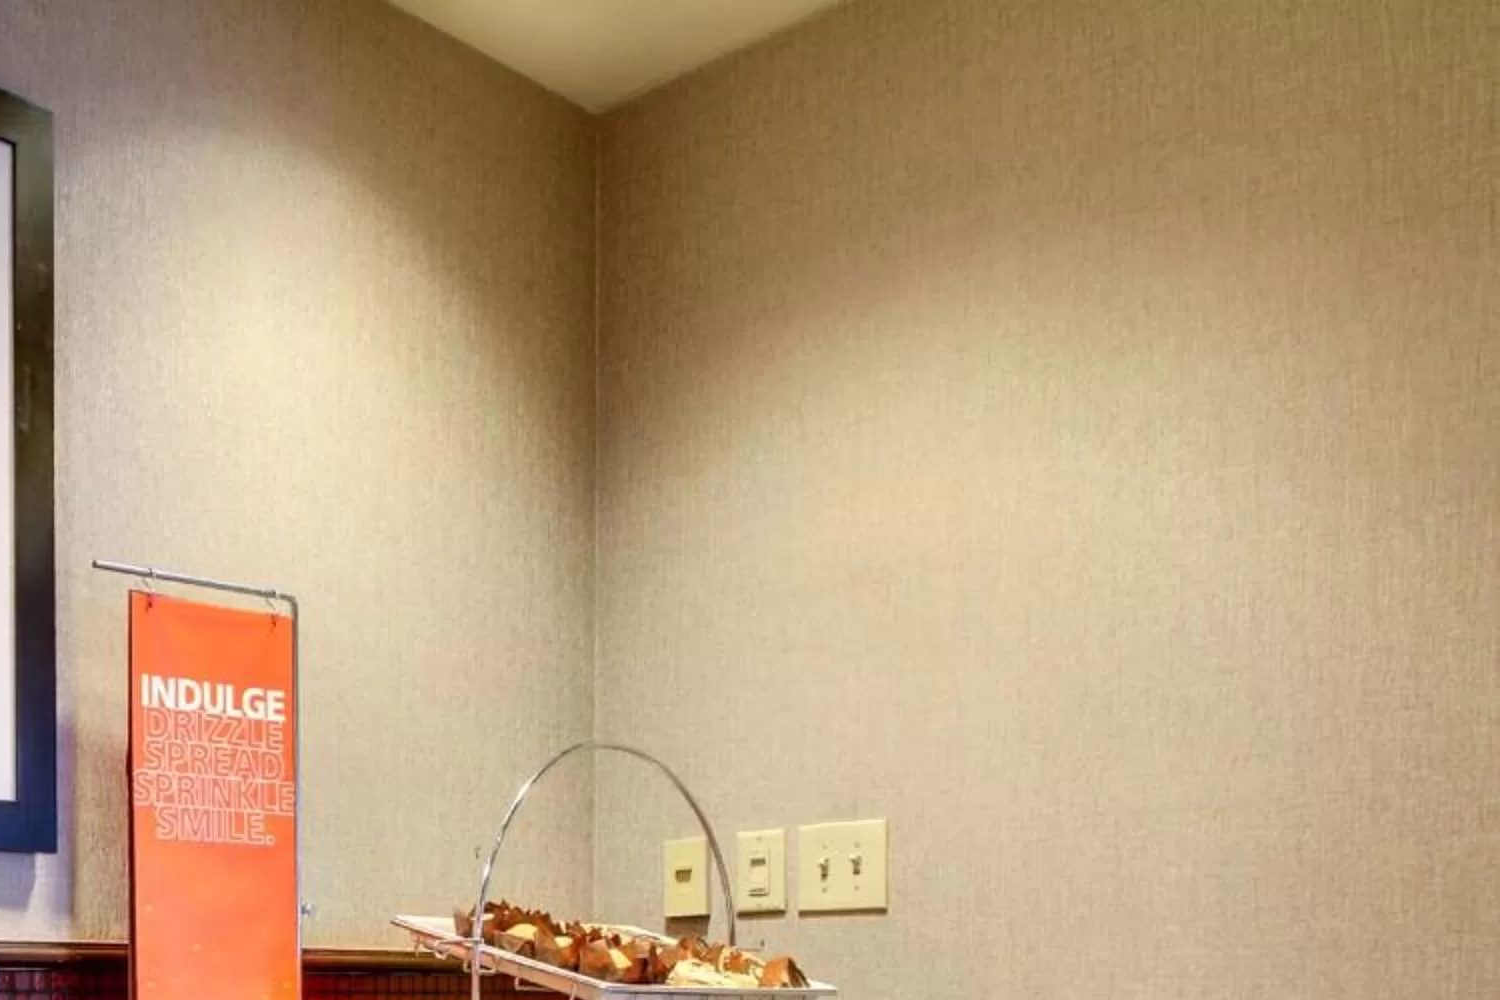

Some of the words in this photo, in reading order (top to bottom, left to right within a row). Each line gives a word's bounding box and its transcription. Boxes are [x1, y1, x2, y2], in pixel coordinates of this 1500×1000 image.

[140, 672, 285, 721] INDULGE
[144, 706, 285, 752] DRIZZLE
[145, 738, 285, 783] SPREAD
[133, 769, 296, 817] SPRINKLE
[155, 804, 276, 846] SMILE.
